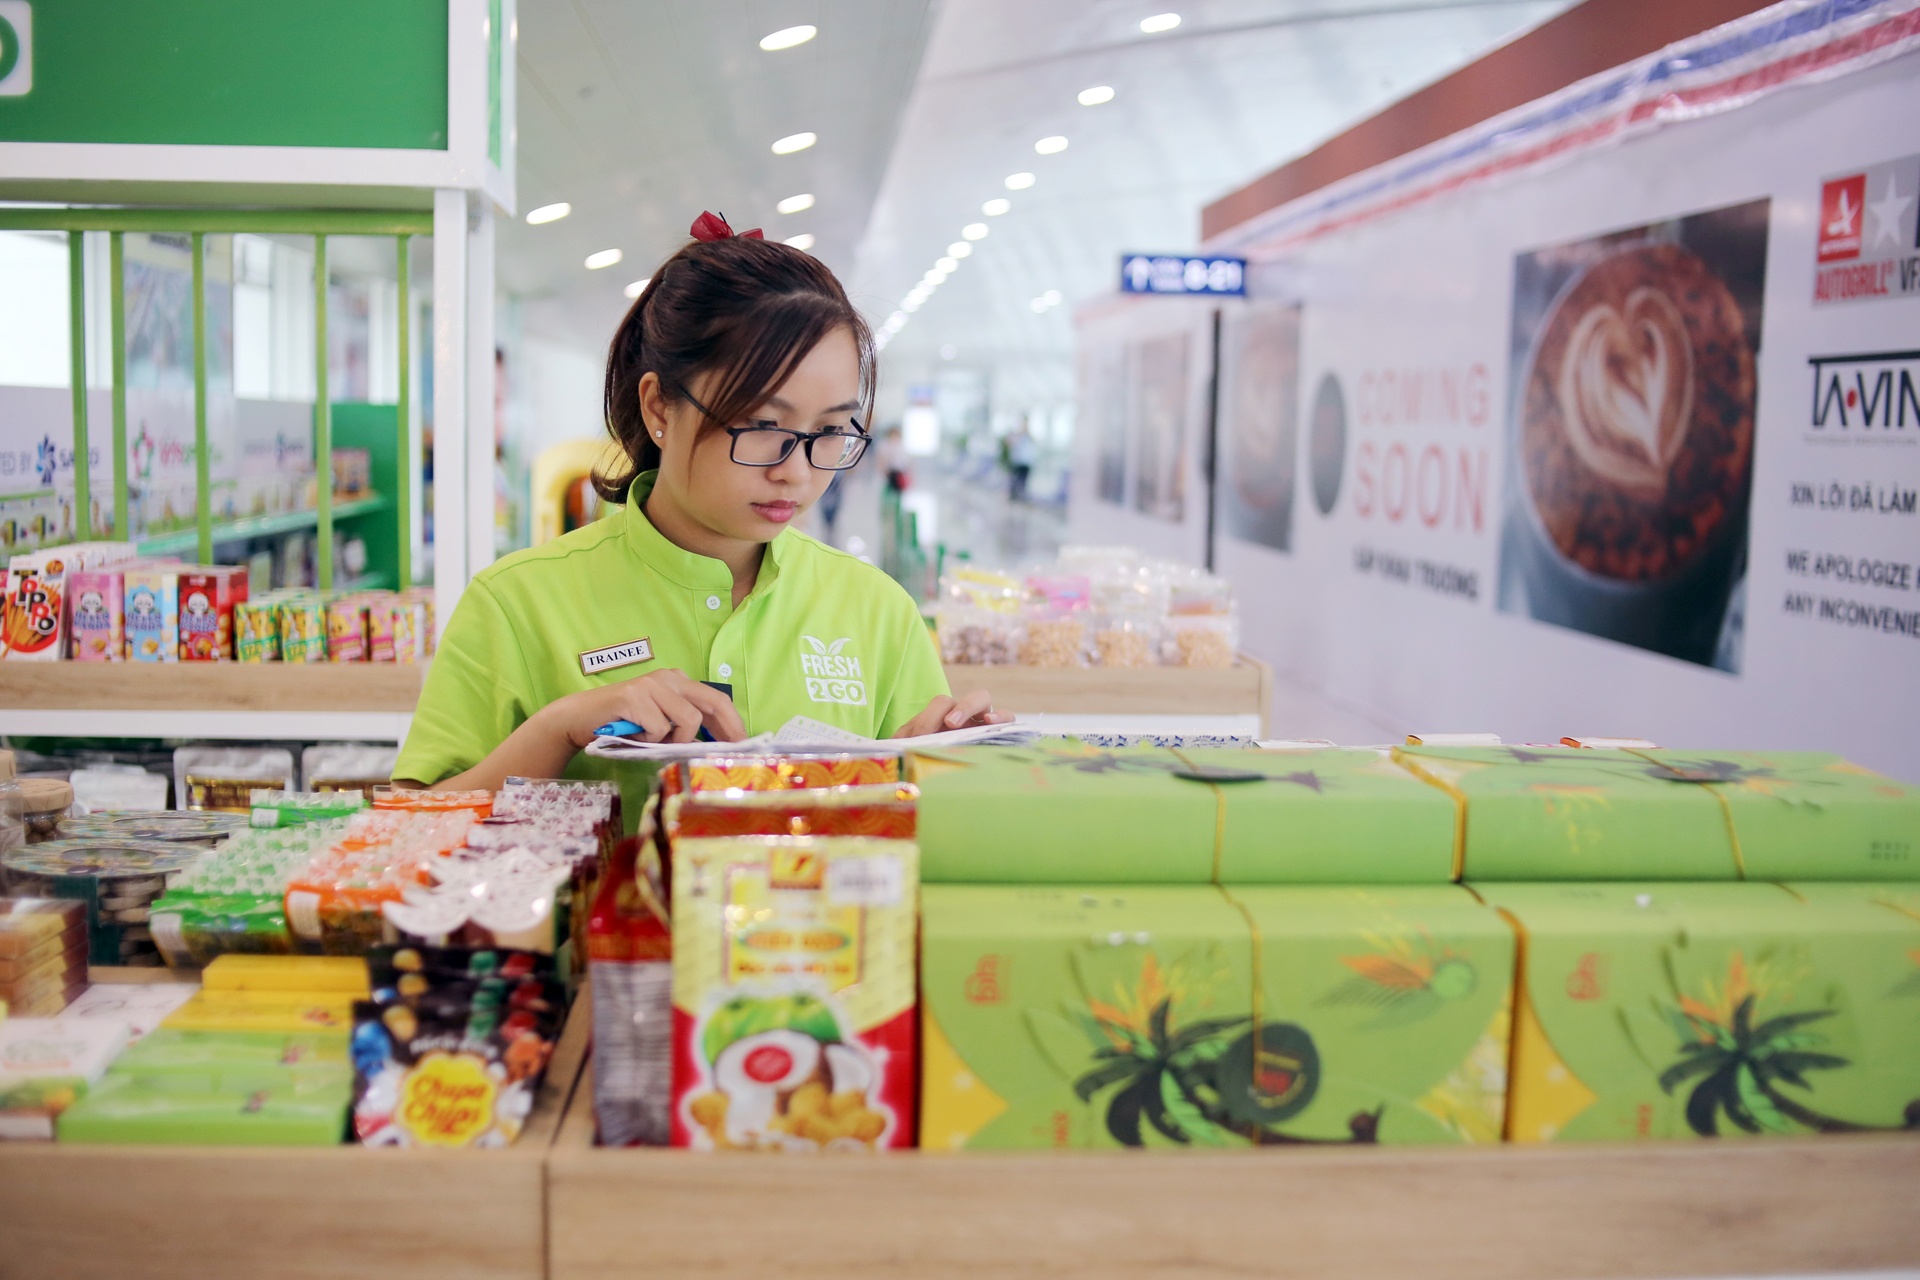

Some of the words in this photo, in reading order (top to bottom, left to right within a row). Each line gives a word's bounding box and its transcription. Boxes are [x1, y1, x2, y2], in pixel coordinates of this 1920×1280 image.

[1354, 440, 1486, 533] SOON
[1814, 553, 1911, 590] APOLOGIZE
[1784, 591, 1814, 616] ANY
[586, 645, 645, 666] TRAINEE
[800, 653, 862, 678] FRESH
[809, 681, 864, 703] 2GO
